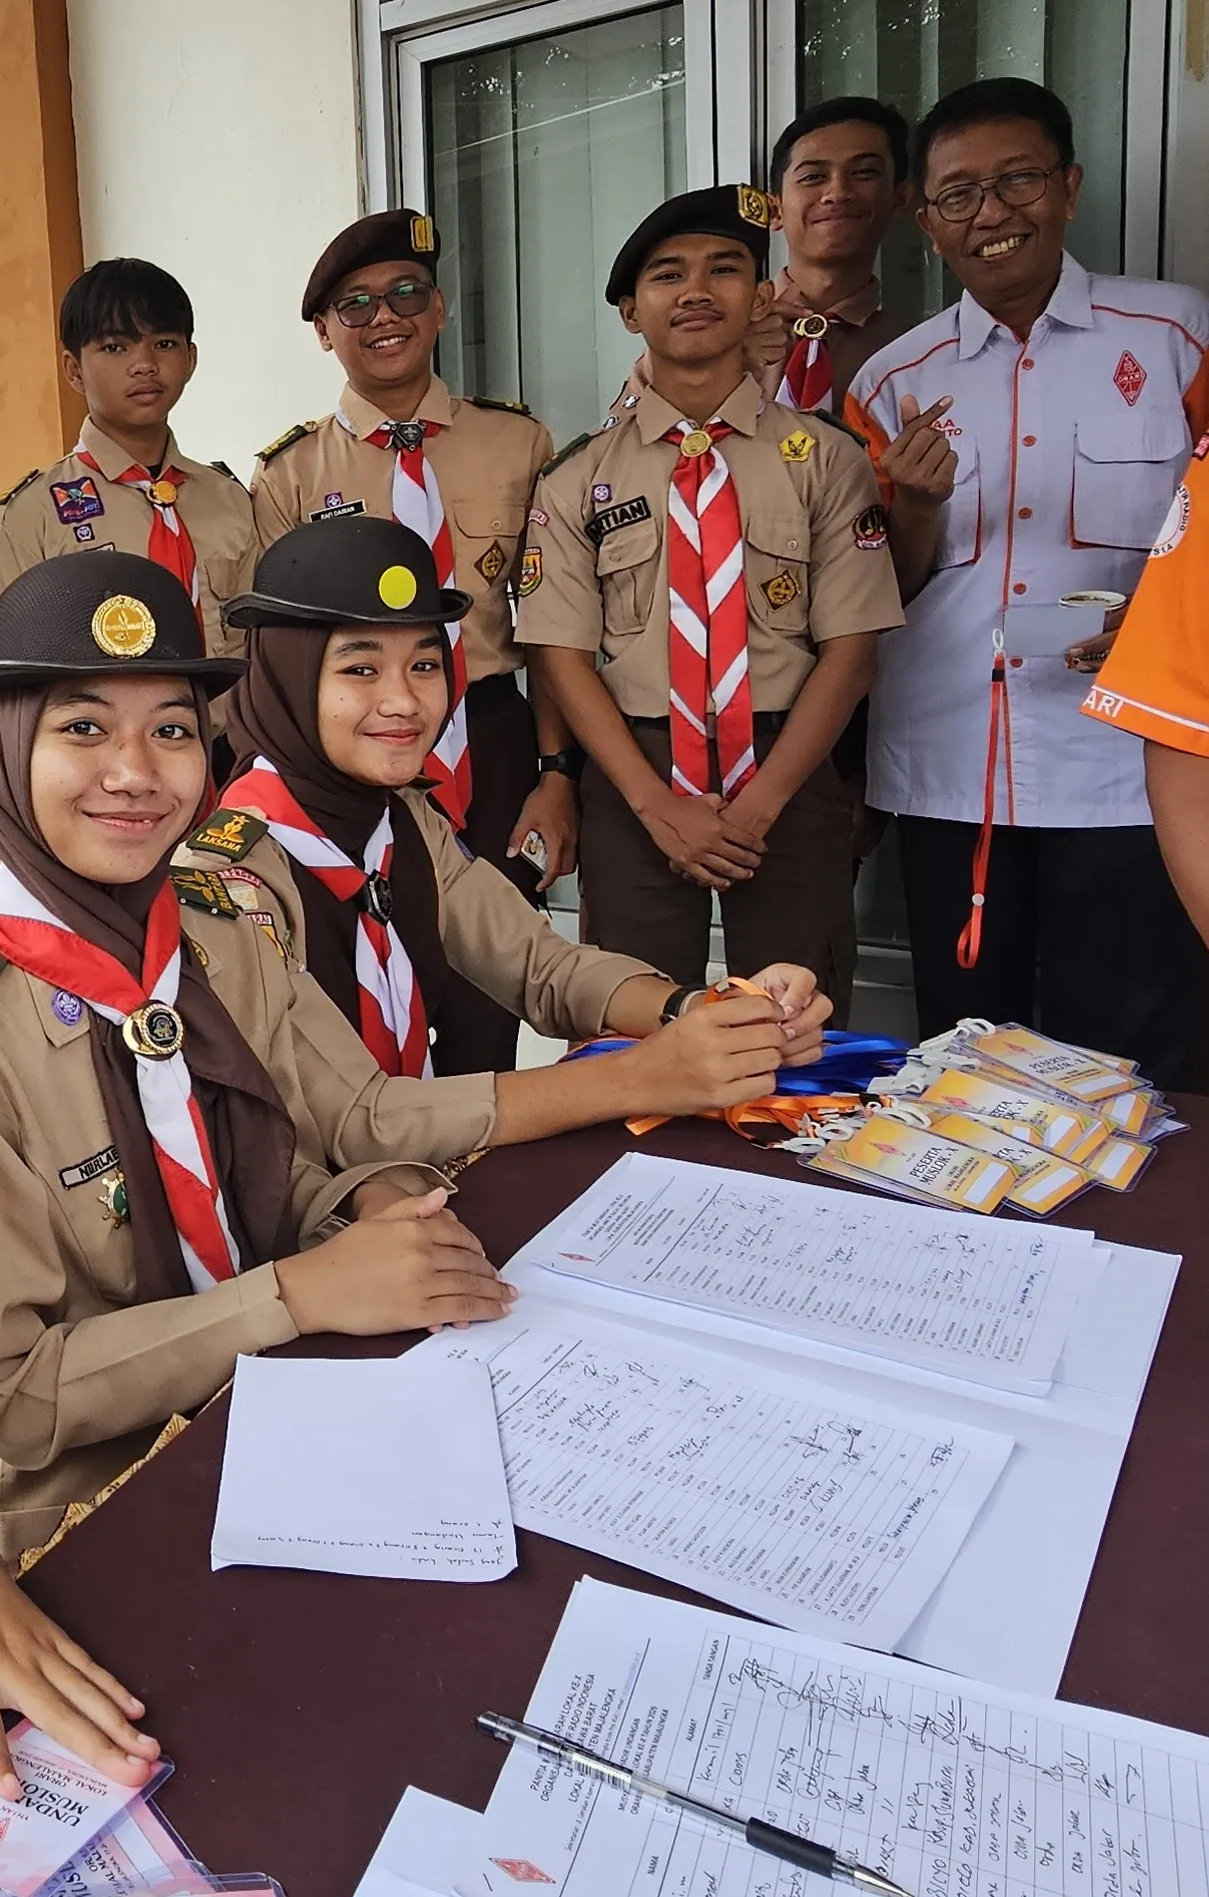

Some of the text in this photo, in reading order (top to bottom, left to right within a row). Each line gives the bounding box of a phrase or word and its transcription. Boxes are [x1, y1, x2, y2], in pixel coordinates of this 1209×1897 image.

[1154, 543, 1173, 556] SIA
[1082, 690, 1123, 718] ARI
[196, 833, 242, 852] LAKSANA
[79, 1148, 120, 1179] NURLAE
[908, 1146, 942, 1177] PESERTA
[919, 1155, 950, 1184] MUSLOK
[581, 1701, 599, 1726] BARAT
[529, 1762, 549, 1791] PANITIA
[560, 1689, 578, 1715] LOKAL
[537, 1756, 565, 1802] ORGANISA
[565, 1707, 583, 1732] RADIO
[574, 1672, 597, 1709] INDONESIA
[573, 1724, 590, 1748] AWA
[682, 1717, 701, 1742] ALAMAT
[567, 1776, 586, 1803] LOKAL
[590, 1686, 619, 1734] MAJALENGKA
[33, 1770, 67, 1788] ORARI
[73, 1778, 107, 1796] LOKAL
[644, 1854, 661, 1876] NAMA
